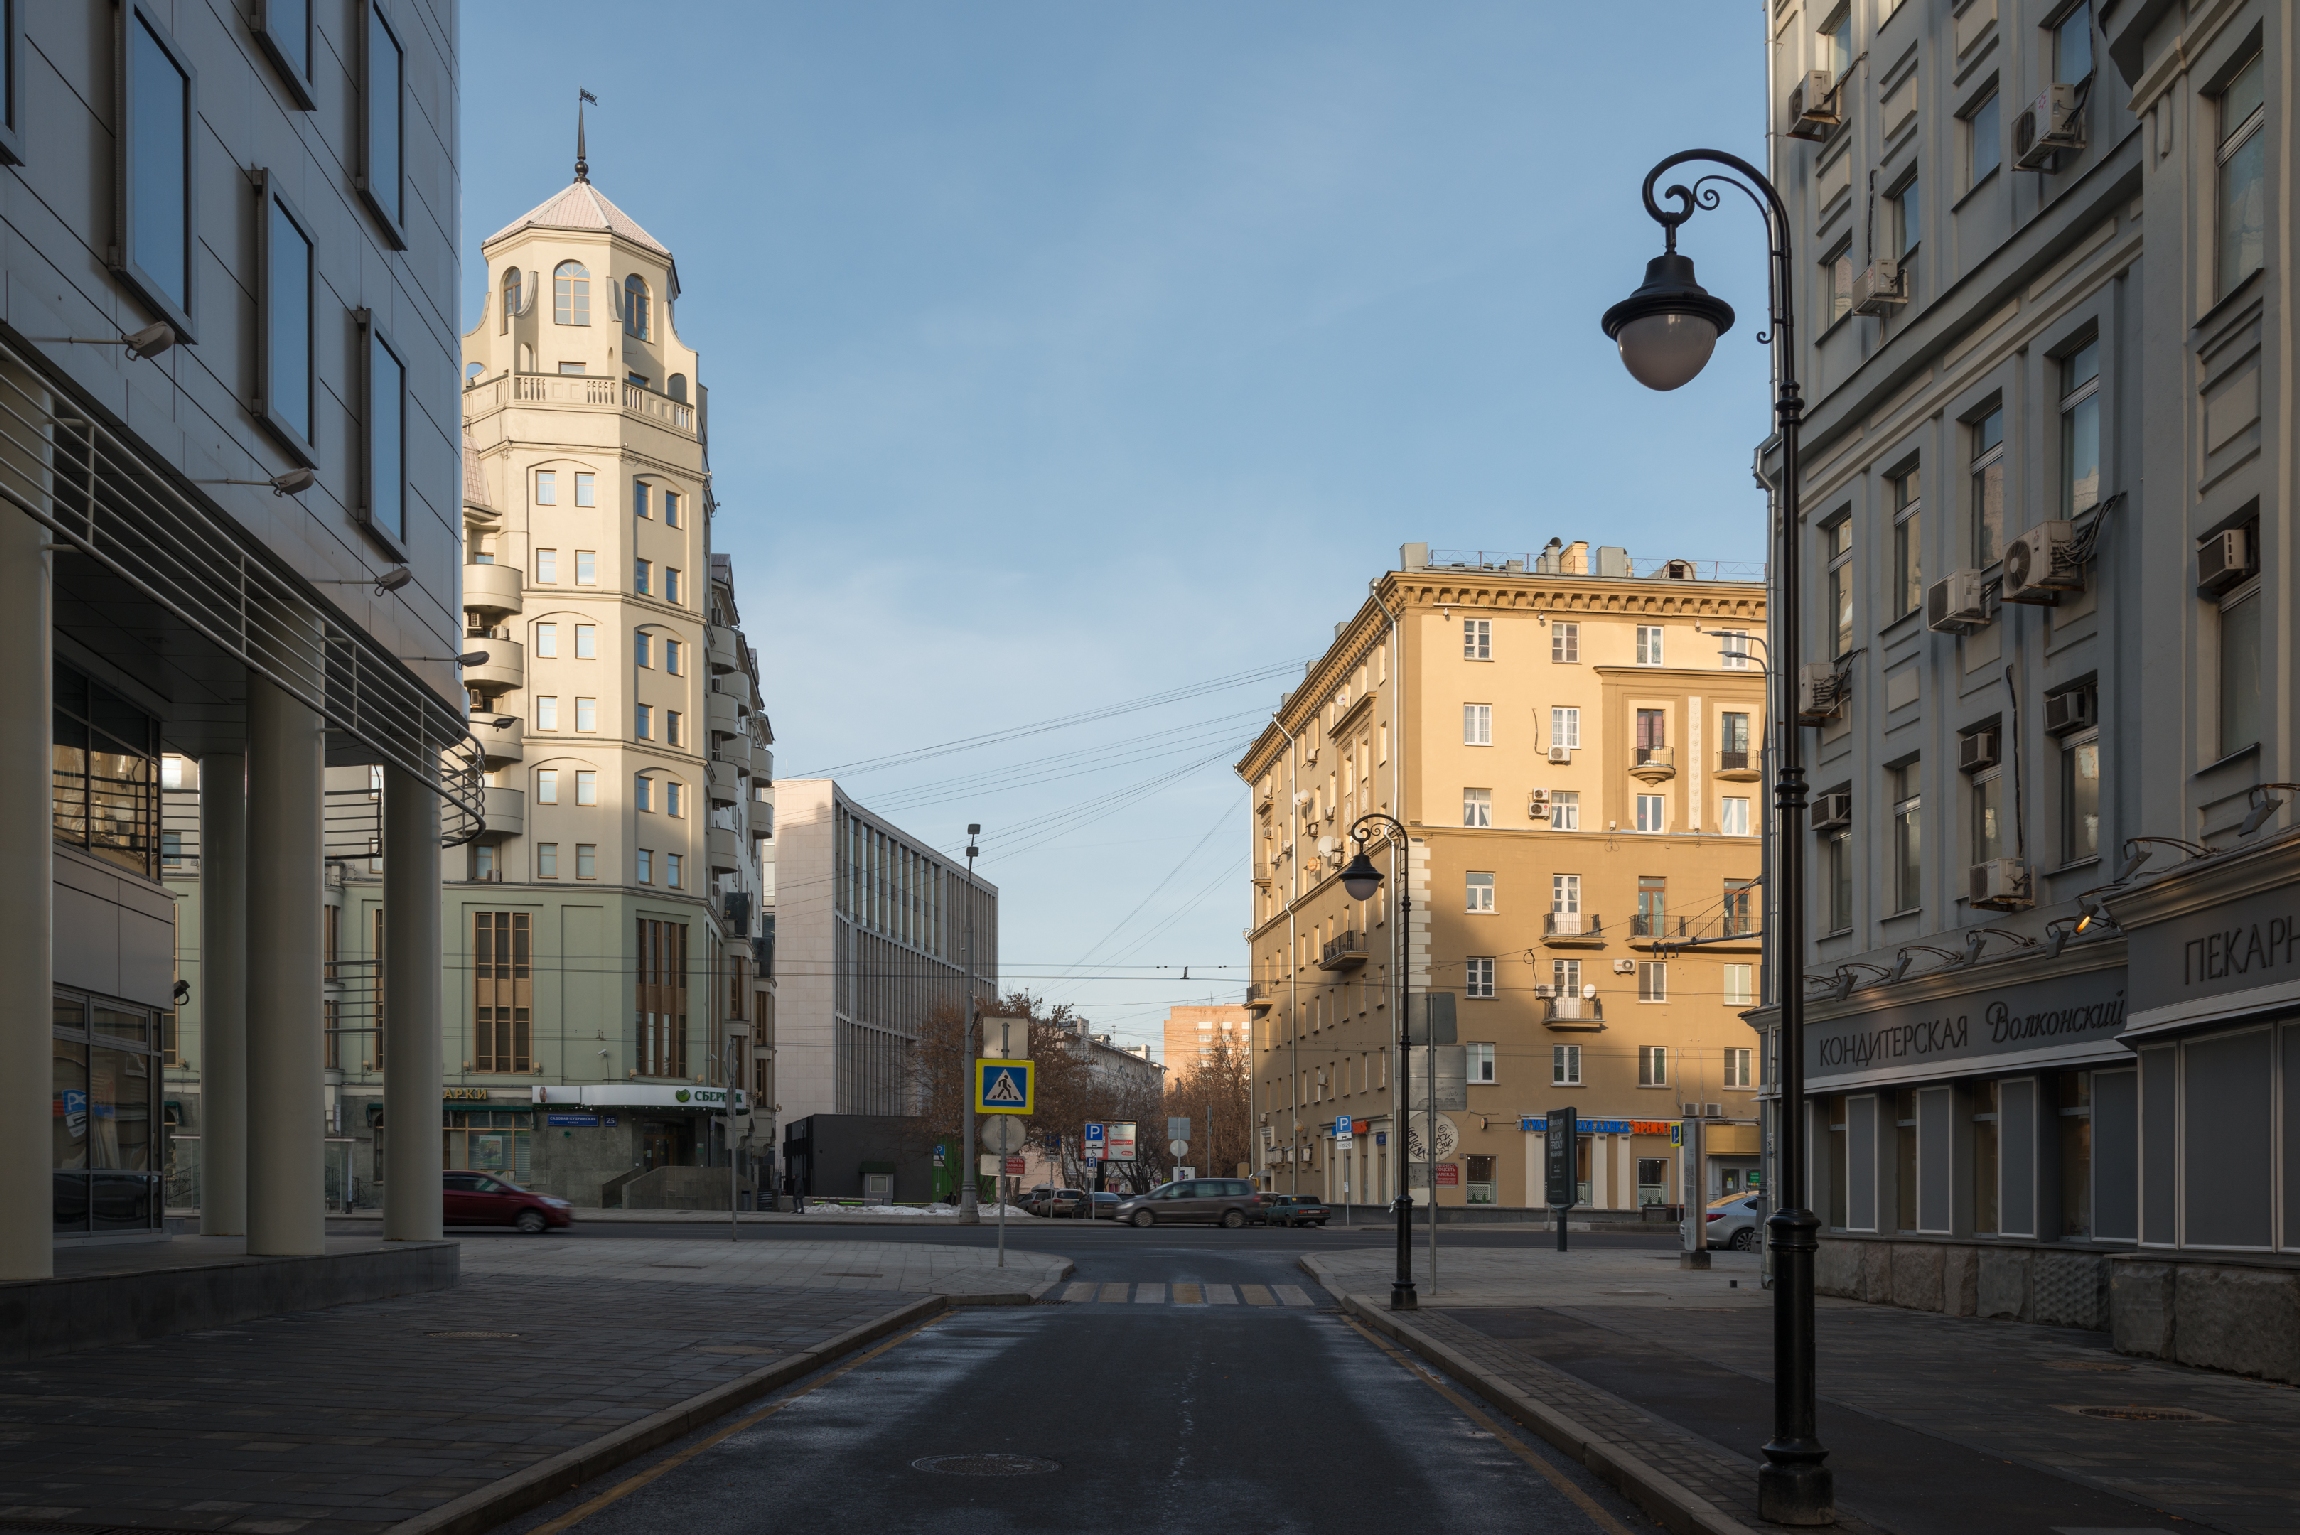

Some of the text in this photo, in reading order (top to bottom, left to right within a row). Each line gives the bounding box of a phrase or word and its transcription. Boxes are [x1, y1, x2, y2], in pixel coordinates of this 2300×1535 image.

[1820, 989, 2125, 1067] КОНДИТЕРСКАЯ Волконский
[443, 1088, 488, 1100] АРКИ
